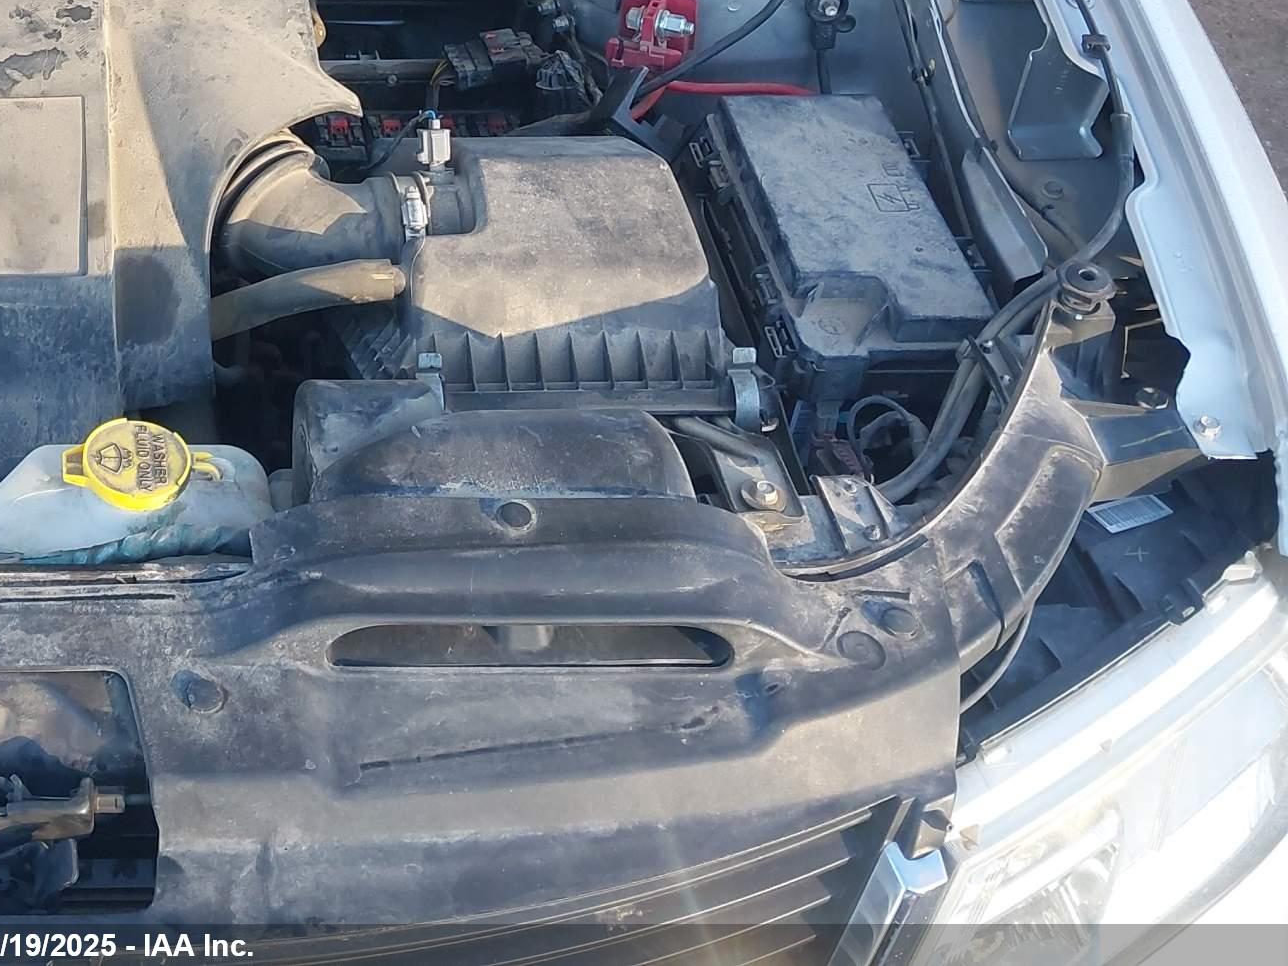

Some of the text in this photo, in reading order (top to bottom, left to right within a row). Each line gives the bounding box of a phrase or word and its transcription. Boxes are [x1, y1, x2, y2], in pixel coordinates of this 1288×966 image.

[135, 425, 153, 491] FLUID ONLY
[152, 434, 168, 484] WASHER
